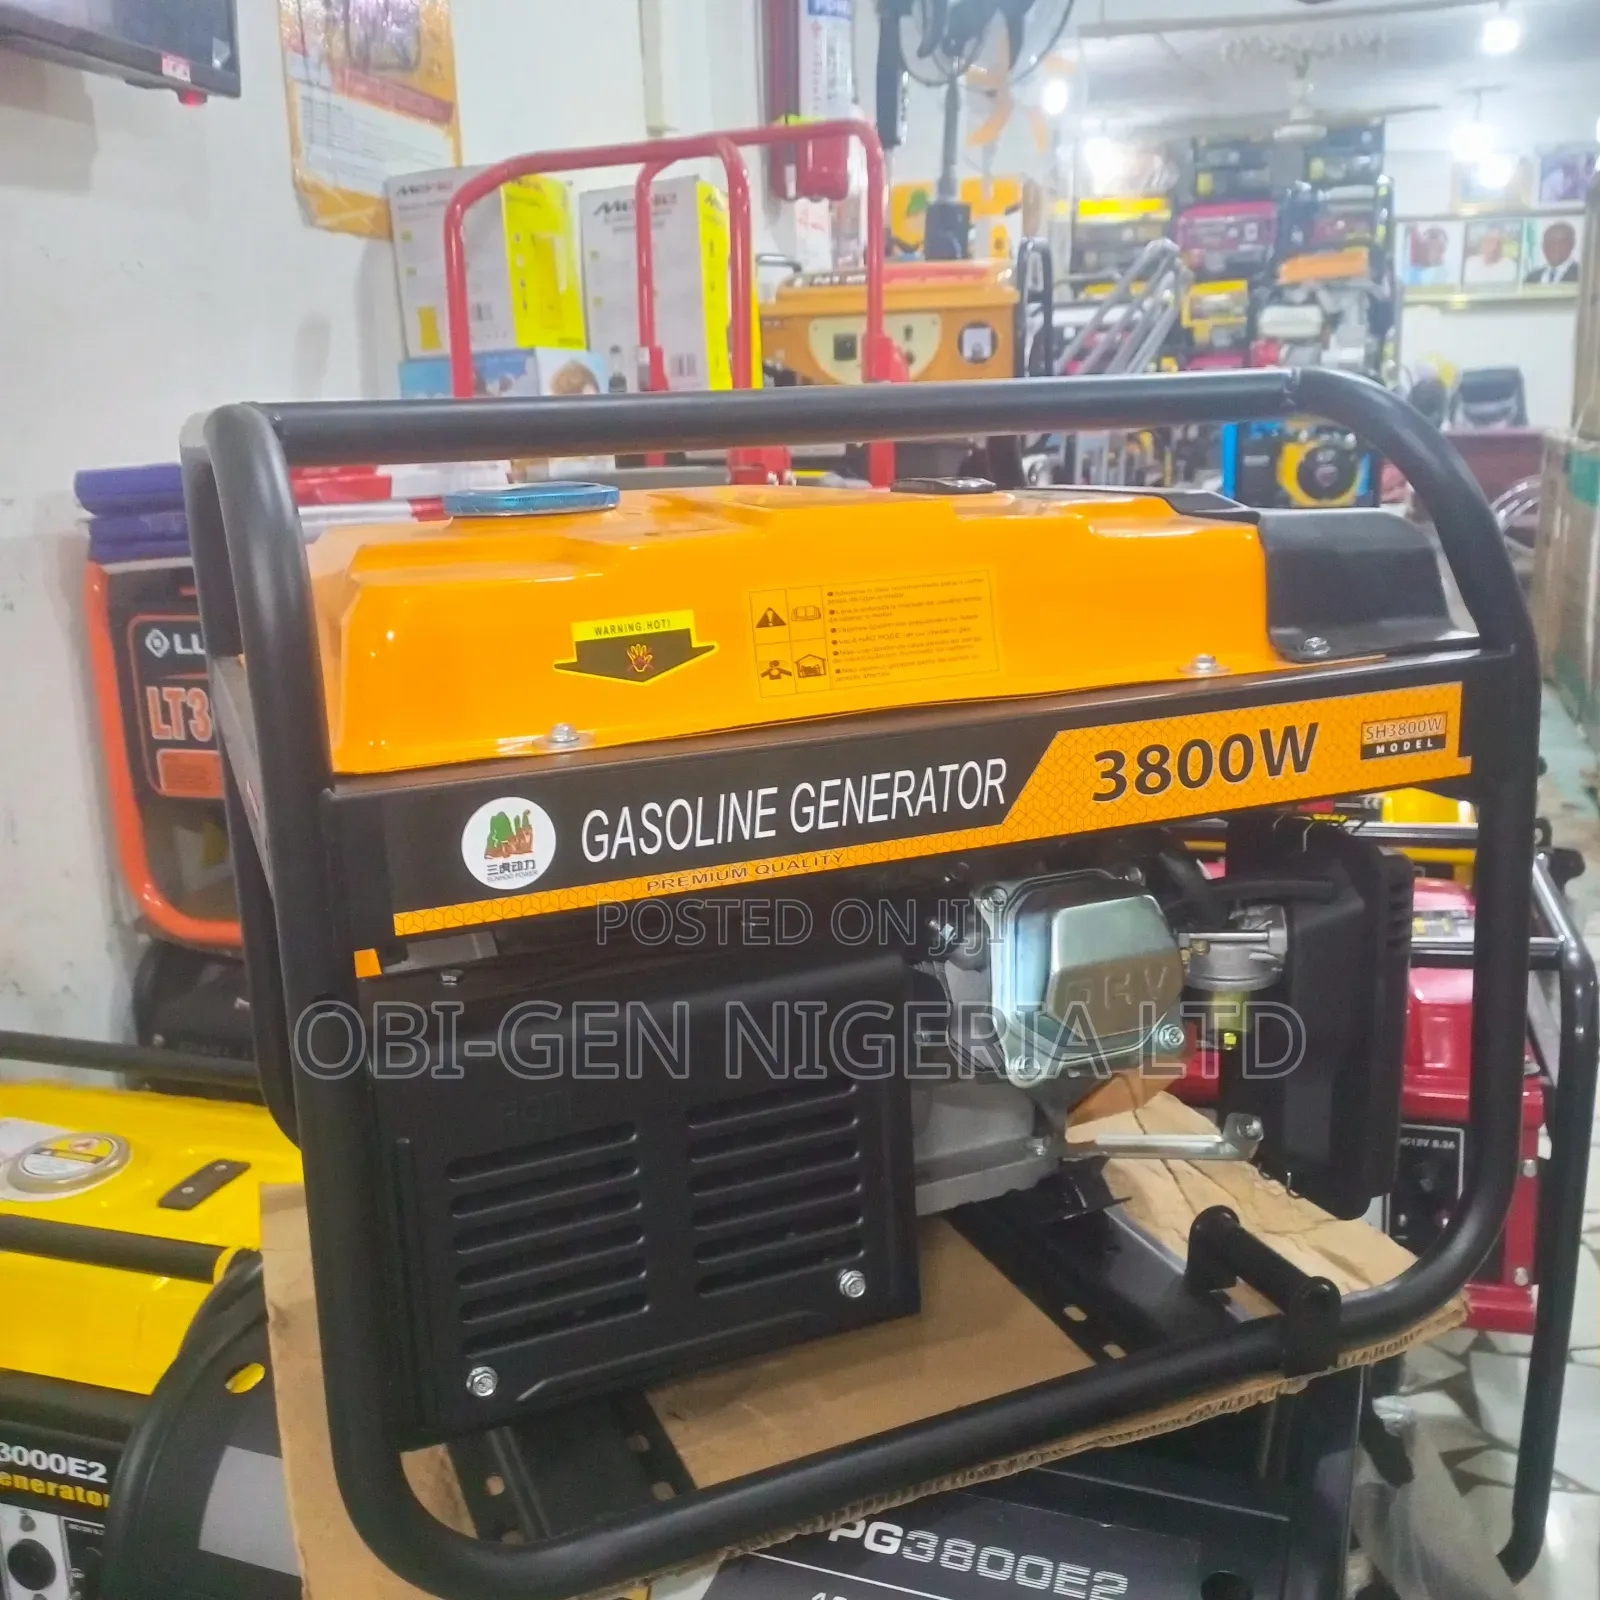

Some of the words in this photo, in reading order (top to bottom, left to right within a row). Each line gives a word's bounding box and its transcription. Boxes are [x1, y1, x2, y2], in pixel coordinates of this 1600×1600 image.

[1366, 716, 1443, 740] SH3800W
[1091, 721, 1320, 802] 3800W
[1375, 738, 1434, 755] MODEL
[581, 786, 778, 863] GASOLINE
[789, 757, 1007, 834] GENERATOR
[515, 869, 538, 879] POWER
[646, 867, 748, 892] PREMIUM
[754, 853, 844, 875] QUALITY
